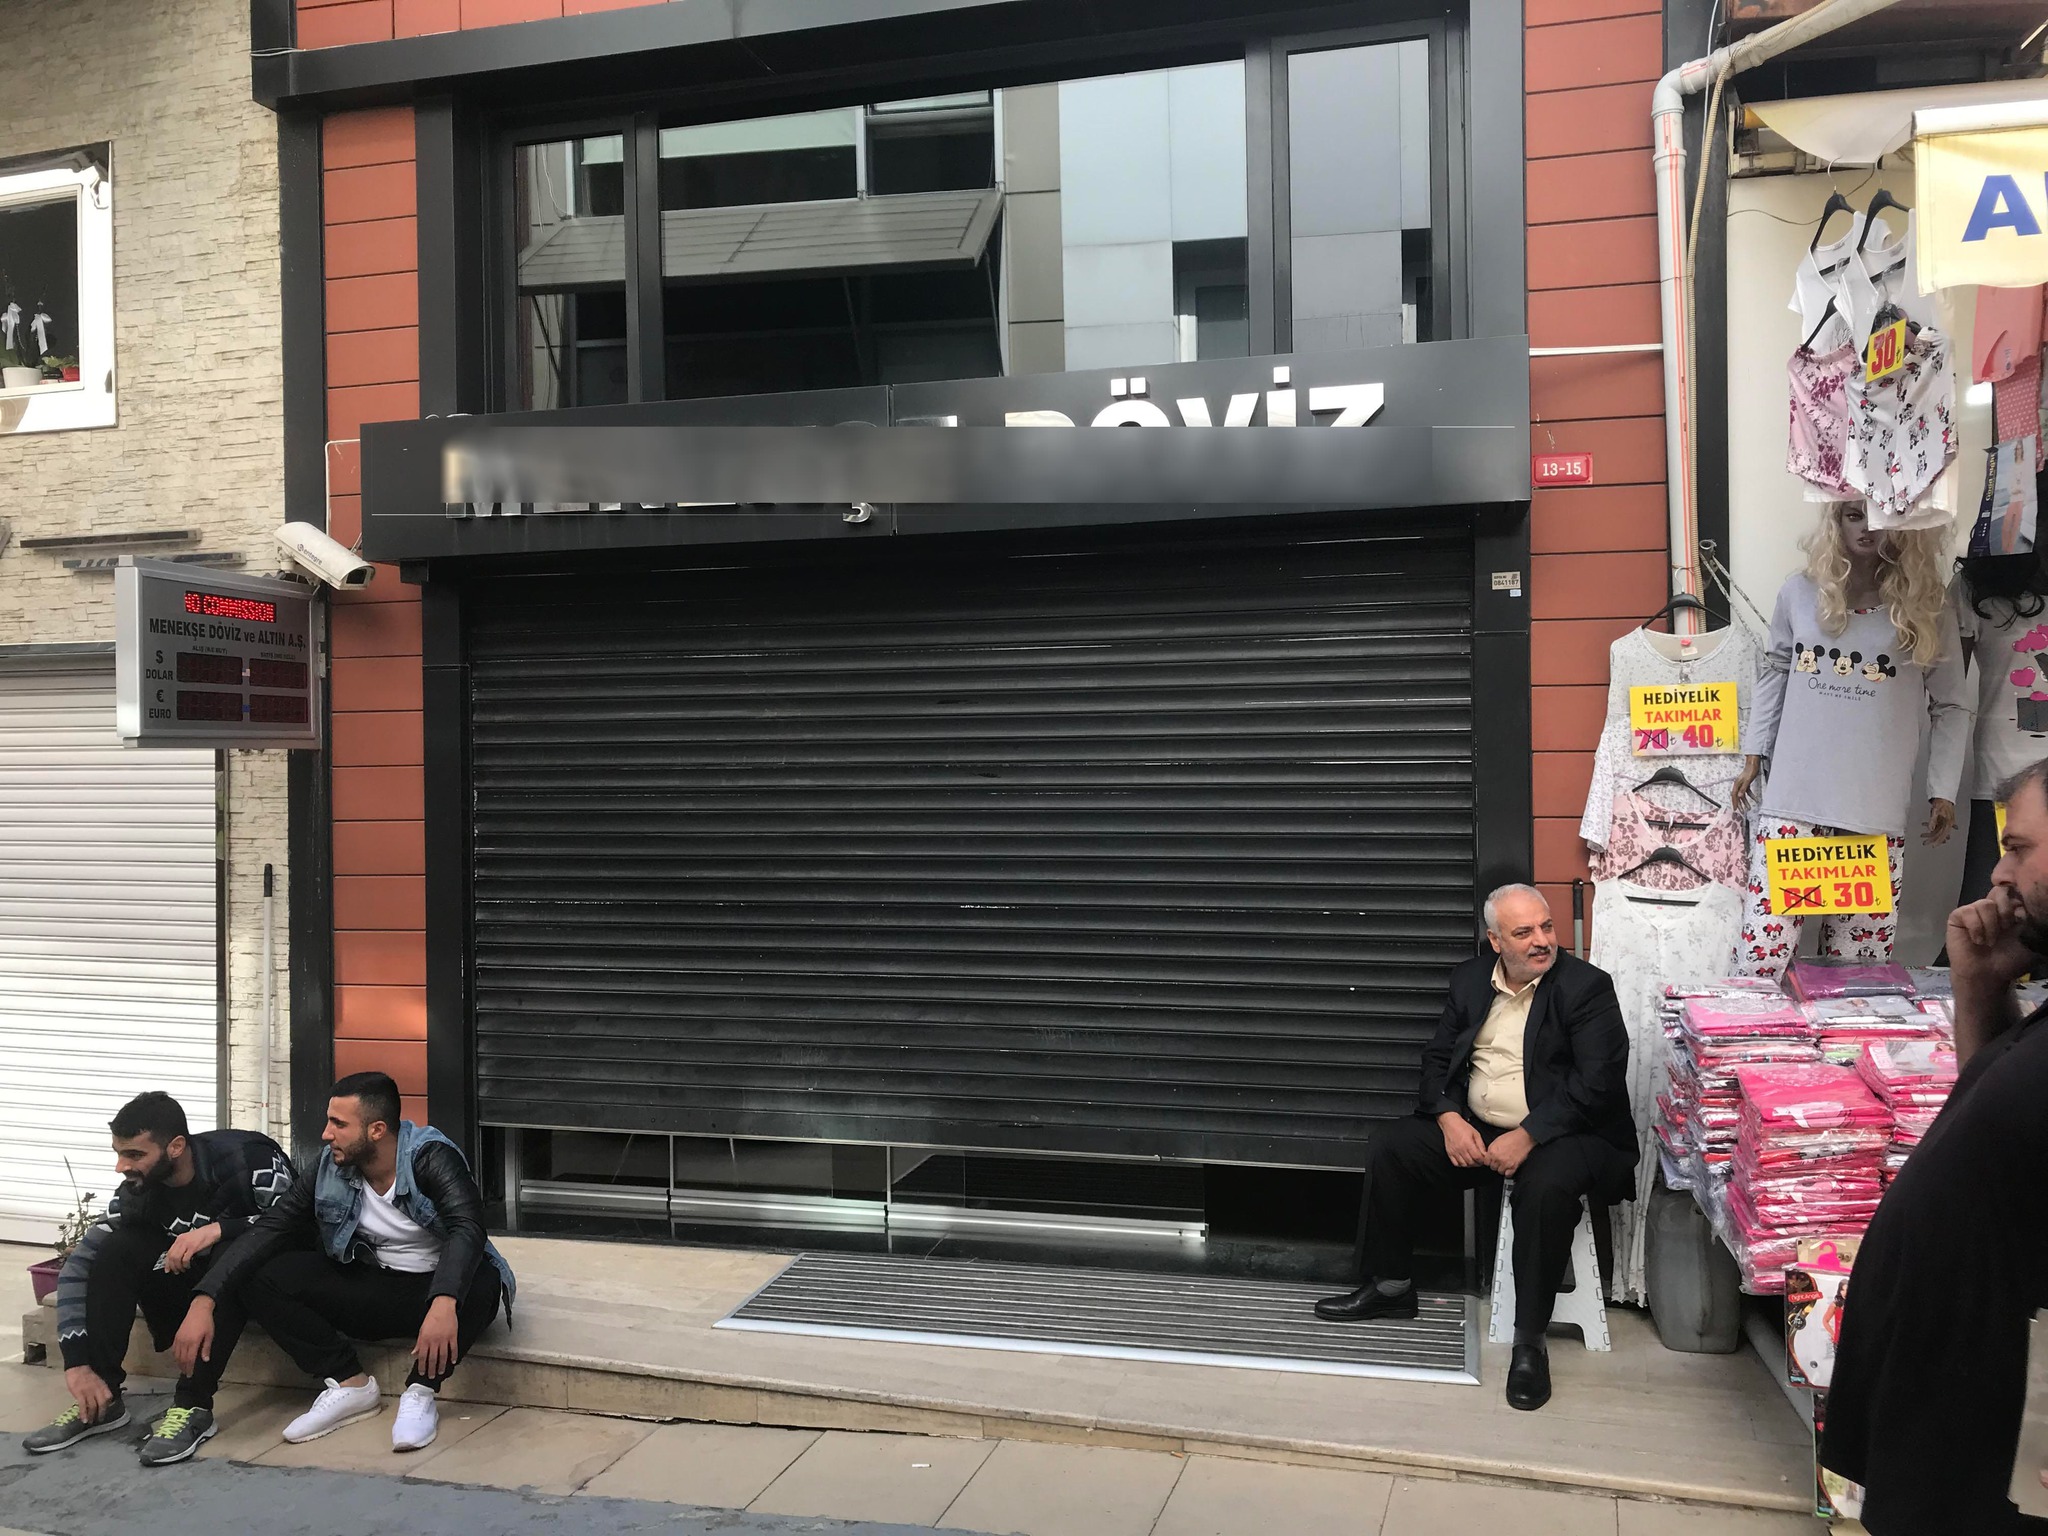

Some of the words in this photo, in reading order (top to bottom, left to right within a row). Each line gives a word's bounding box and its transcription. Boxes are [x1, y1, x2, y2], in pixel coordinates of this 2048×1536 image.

[1961, 171, 2048, 242] A
[1871, 328, 1896, 375] 30
[1542, 462, 1582, 476] 13-15
[149, 618, 205, 641] MENEKŞE
[209, 621, 241, 642] DÖVİZ
[243, 632, 255, 643] ve
[257, 630, 285, 647] ALTIN
[288, 634, 306, 652] A.Ş.
[146, 668, 173, 680] DOLAR
[1808, 677, 1827, 690] One
[1829, 684, 1851, 694] more
[1643, 687, 1720, 705] HEDİYELİK
[149, 708, 171, 719] EURO
[1644, 708, 1722, 723] TAKIMLAR
[1682, 724, 1714, 748] 40
[1778, 864, 1877, 880] TAKIMLAR
[1833, 882, 1874, 907] 30
